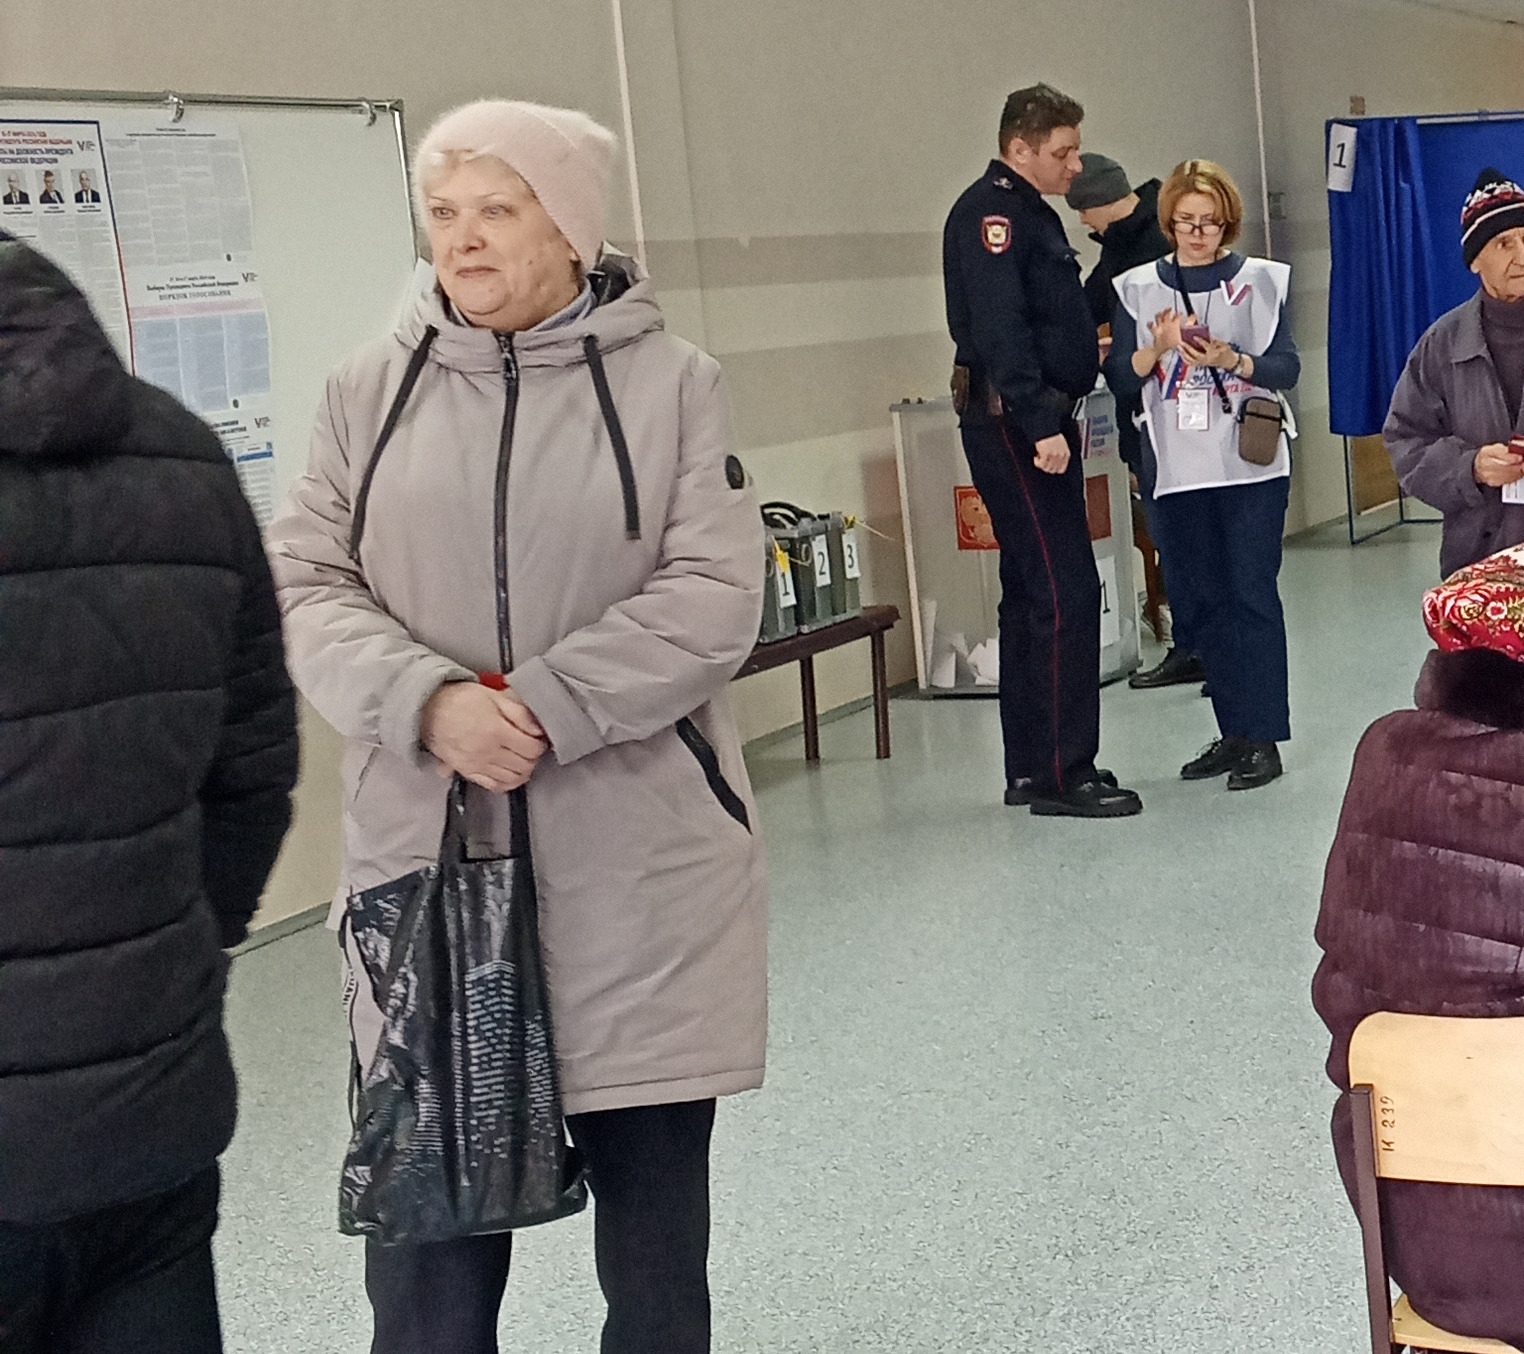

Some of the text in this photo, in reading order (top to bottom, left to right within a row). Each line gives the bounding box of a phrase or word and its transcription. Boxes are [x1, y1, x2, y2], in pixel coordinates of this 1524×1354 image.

[1332, 142, 1347, 169] 1
[818, 551, 826, 576] 2
[847, 544, 855, 569] 3
[781, 571, 791, 597] 1
[1100, 580, 1111, 615] 1
